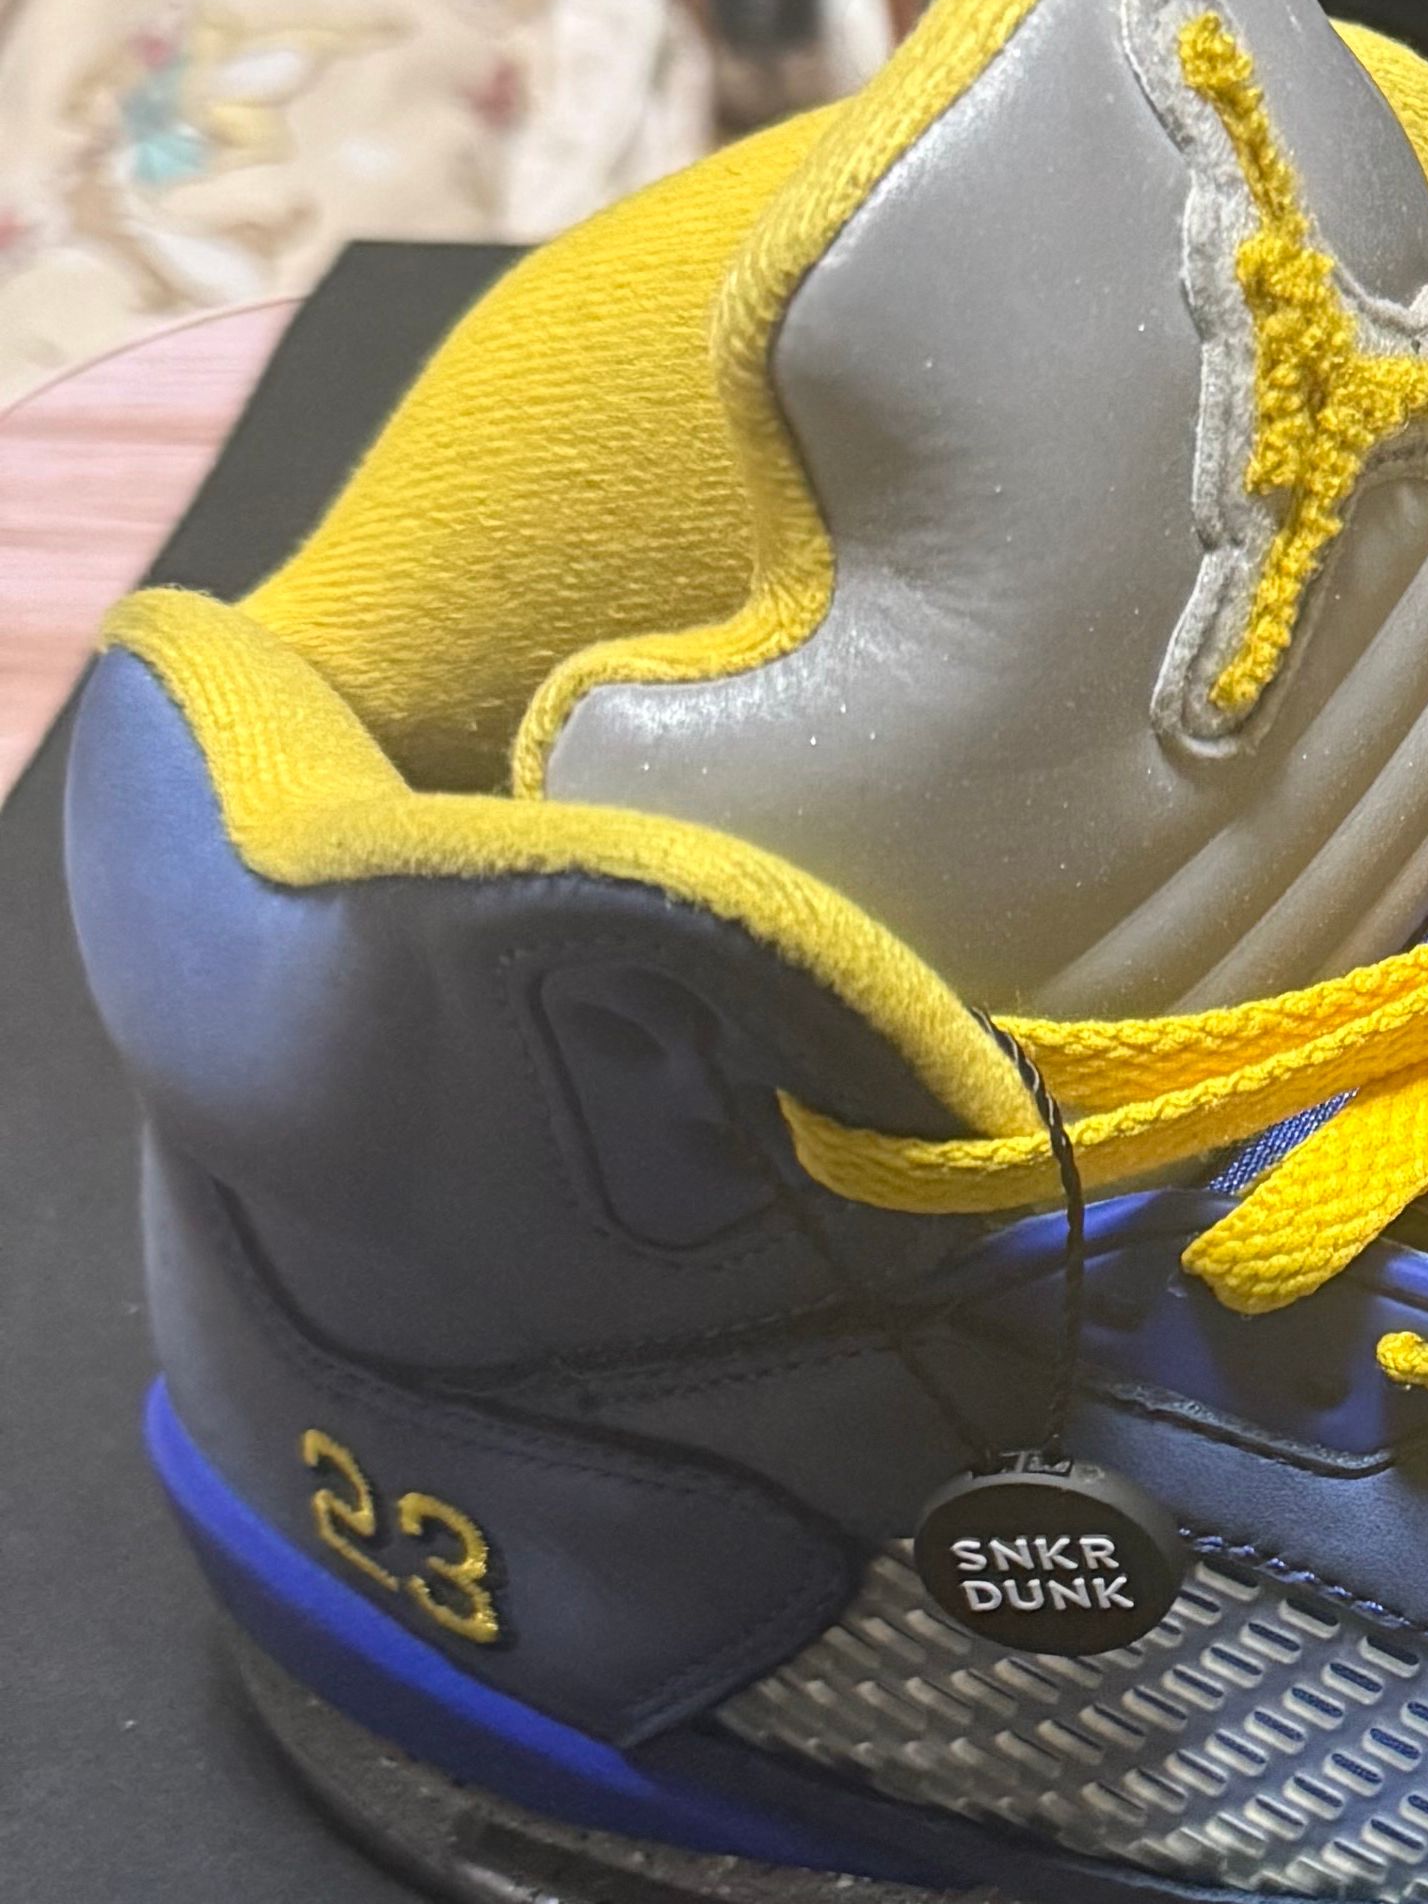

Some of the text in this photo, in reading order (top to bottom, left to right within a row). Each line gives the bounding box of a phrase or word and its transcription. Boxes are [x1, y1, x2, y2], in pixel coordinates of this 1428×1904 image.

[301, 1428, 499, 1643] 23
[950, 1536, 1120, 1571] SNKR
[961, 1577, 1135, 1611] DUNK
